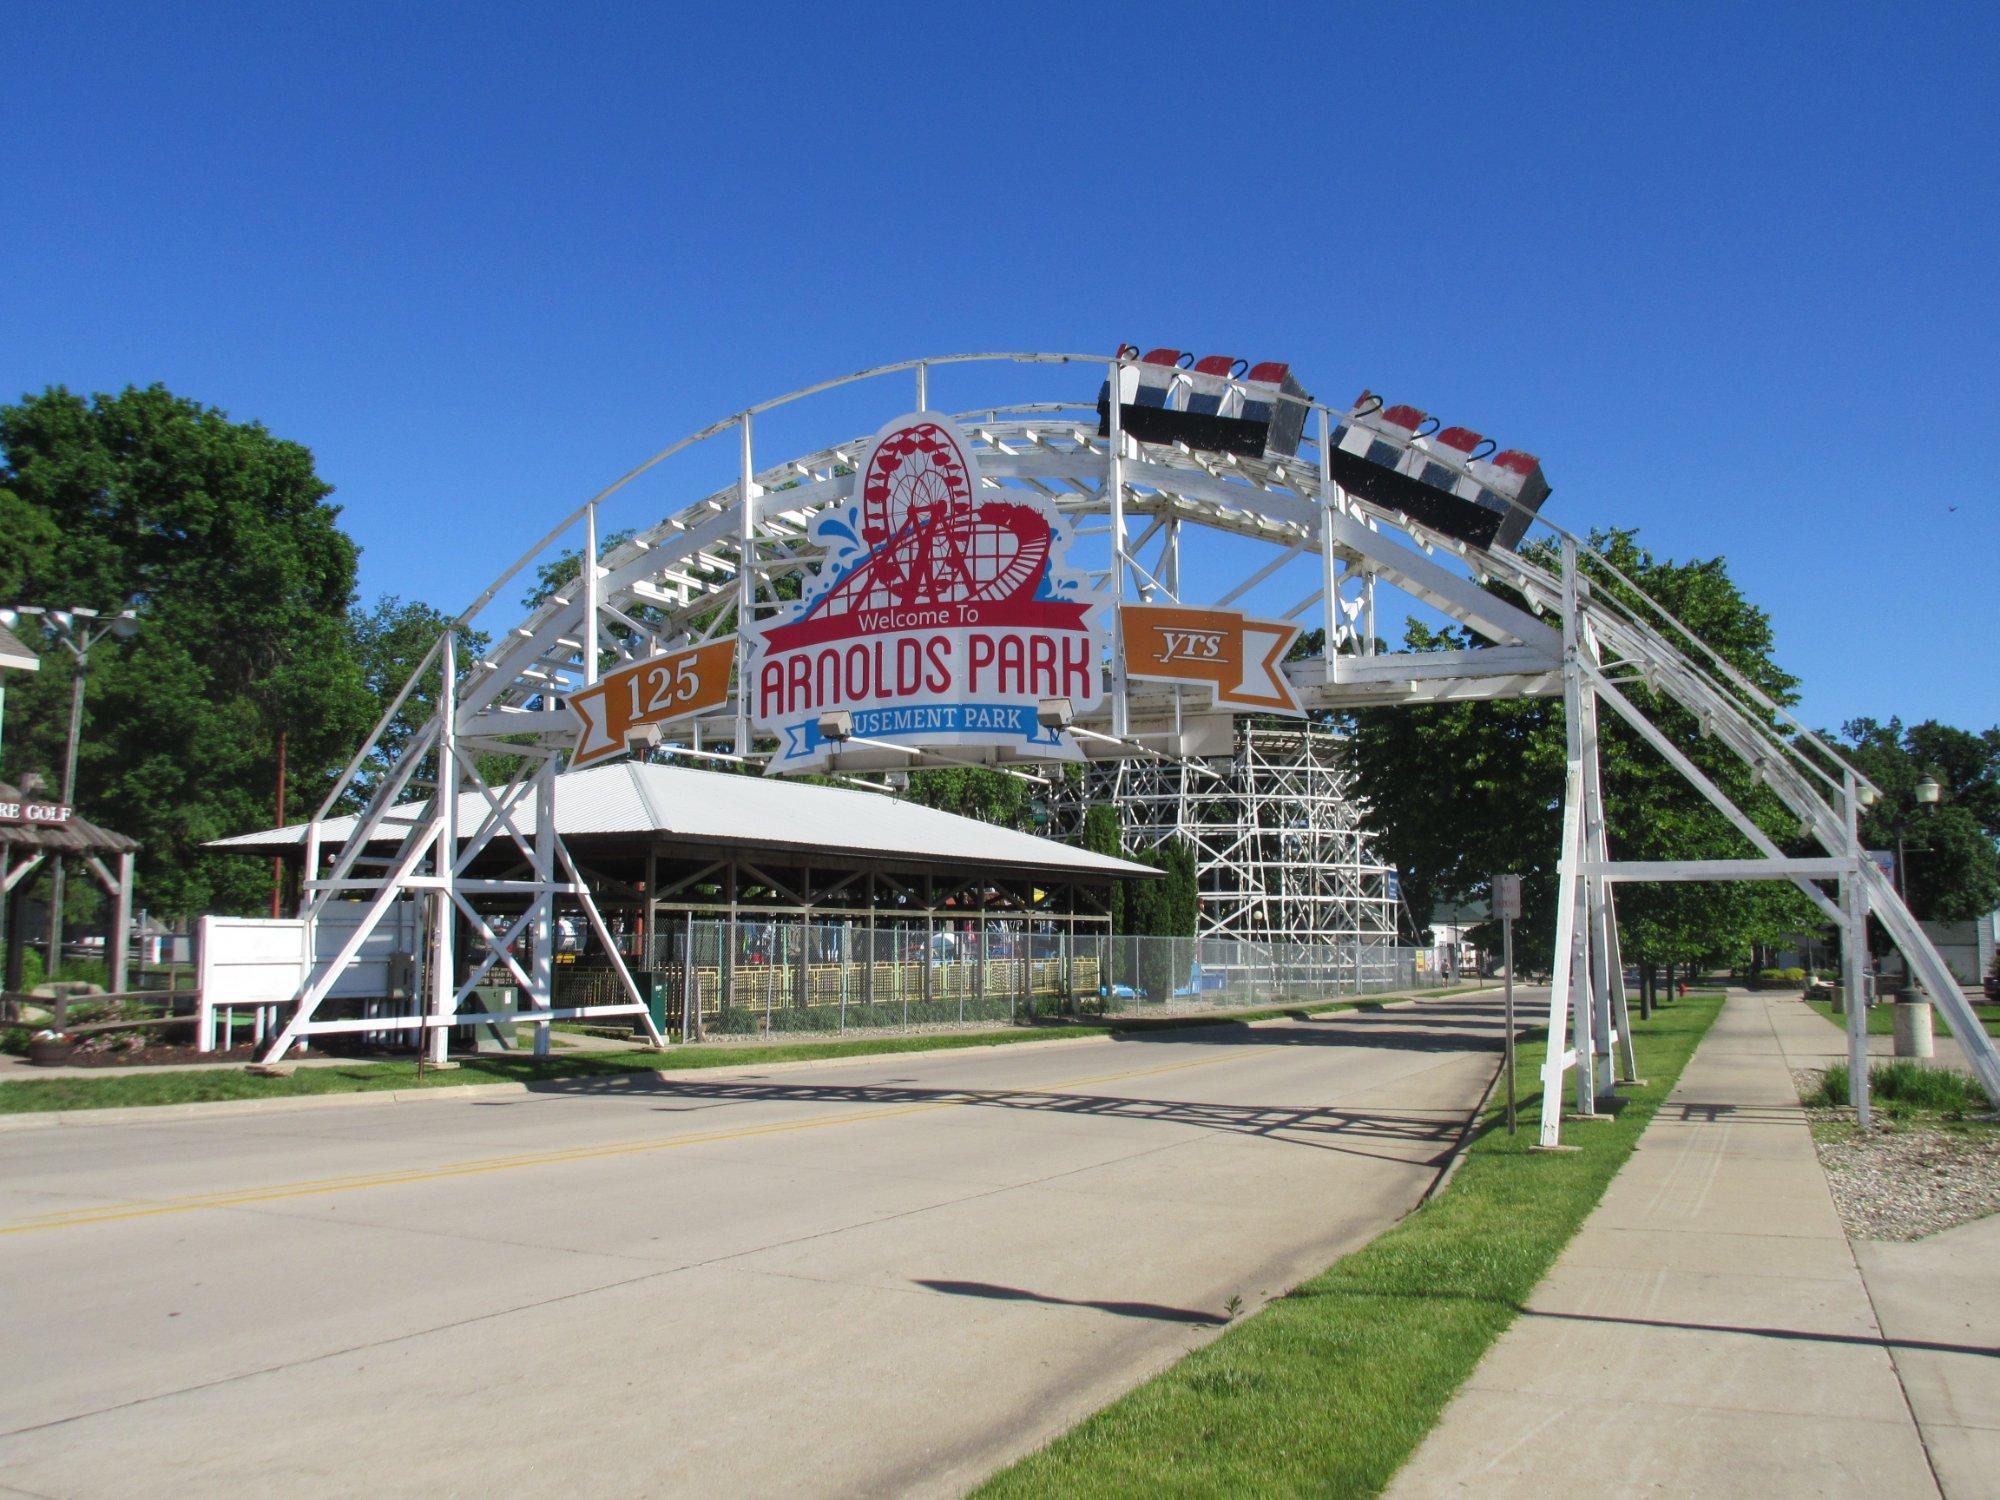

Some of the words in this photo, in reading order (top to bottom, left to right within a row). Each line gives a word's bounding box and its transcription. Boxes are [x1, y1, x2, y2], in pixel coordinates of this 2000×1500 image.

[859, 610, 950, 632] Welcome
[956, 605, 979, 623] To
[1160, 633, 1221, 663] yrs
[627, 654, 700, 720] 125
[761, 635, 951, 718] ARNOLDS
[969, 634, 1090, 698] PARK
[849, 708, 957, 734] USEMENT
[965, 708, 1021, 729] PARK
[26, 805, 72, 821] GOLF
